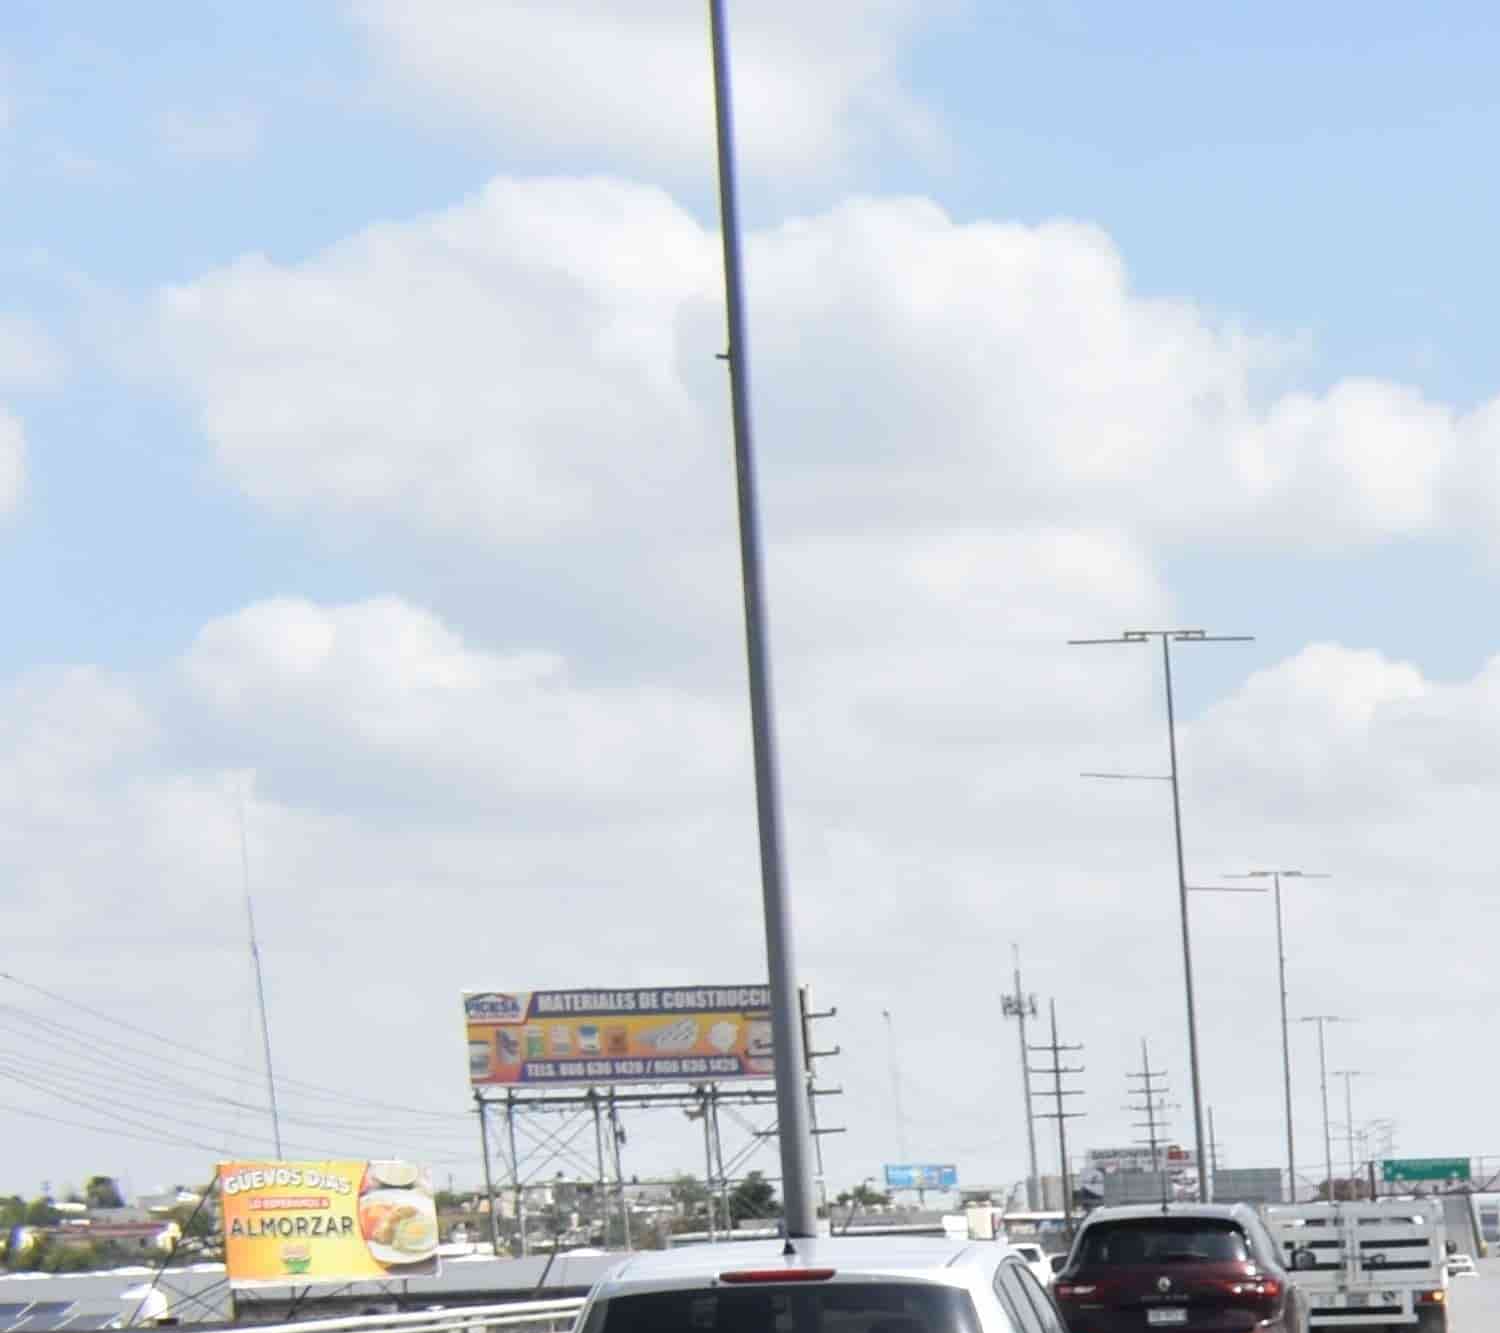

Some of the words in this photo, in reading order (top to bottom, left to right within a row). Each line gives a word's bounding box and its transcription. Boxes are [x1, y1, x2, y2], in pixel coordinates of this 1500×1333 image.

[537, 991, 636, 1011] MATERIALES
[638, 991, 658, 1009] DE
[231, 1215, 354, 1237] ALMORZAR
